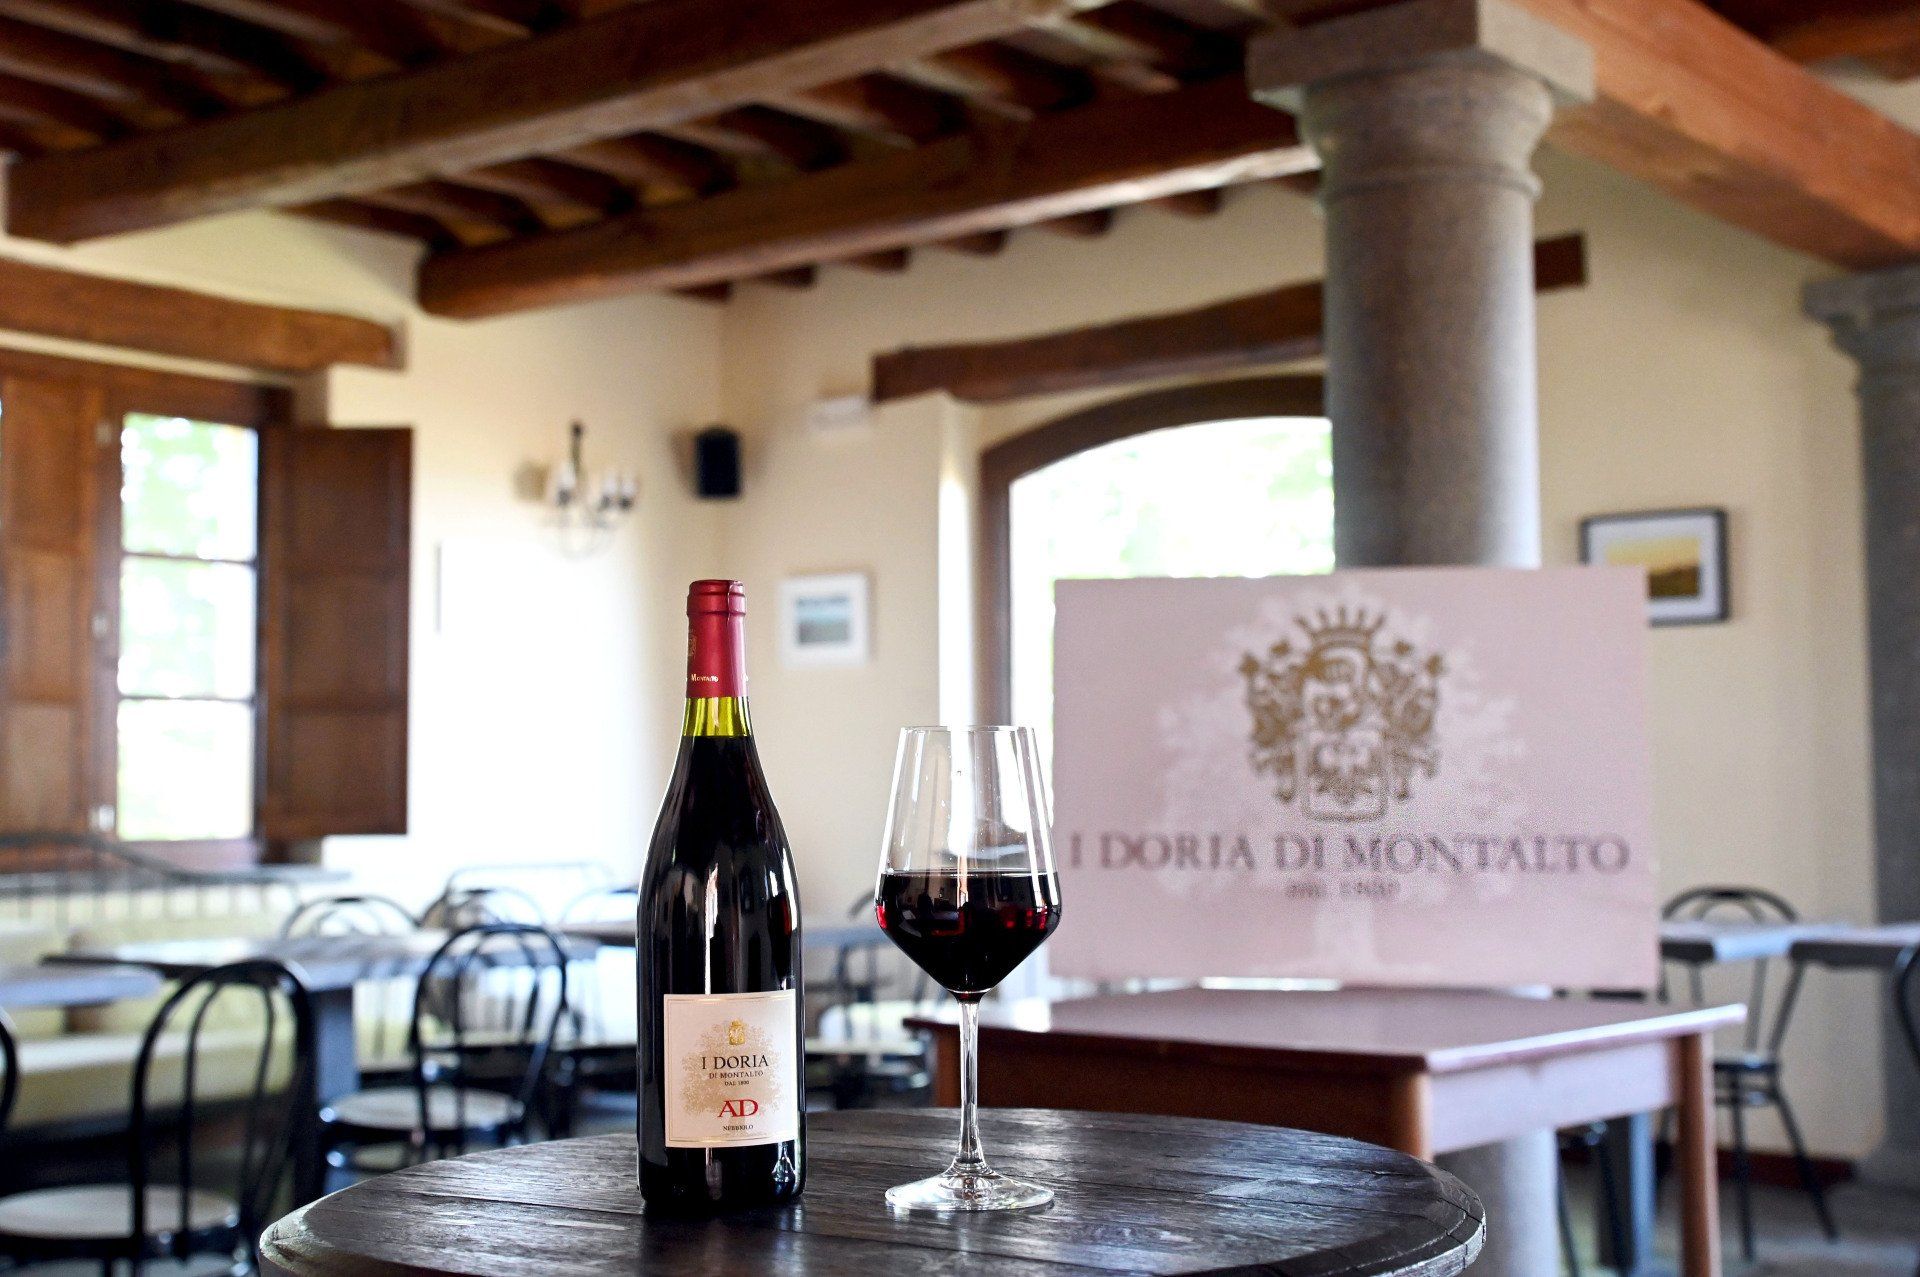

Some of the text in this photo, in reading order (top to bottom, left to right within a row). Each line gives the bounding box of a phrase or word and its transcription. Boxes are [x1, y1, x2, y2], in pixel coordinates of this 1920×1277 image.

[1070, 831, 1631, 874] I DORIA DI MONTALTO
[702, 1055, 769, 1070] I DORIA
[720, 1070, 764, 1079] MONTALTO
[717, 1099, 759, 1118] AD
